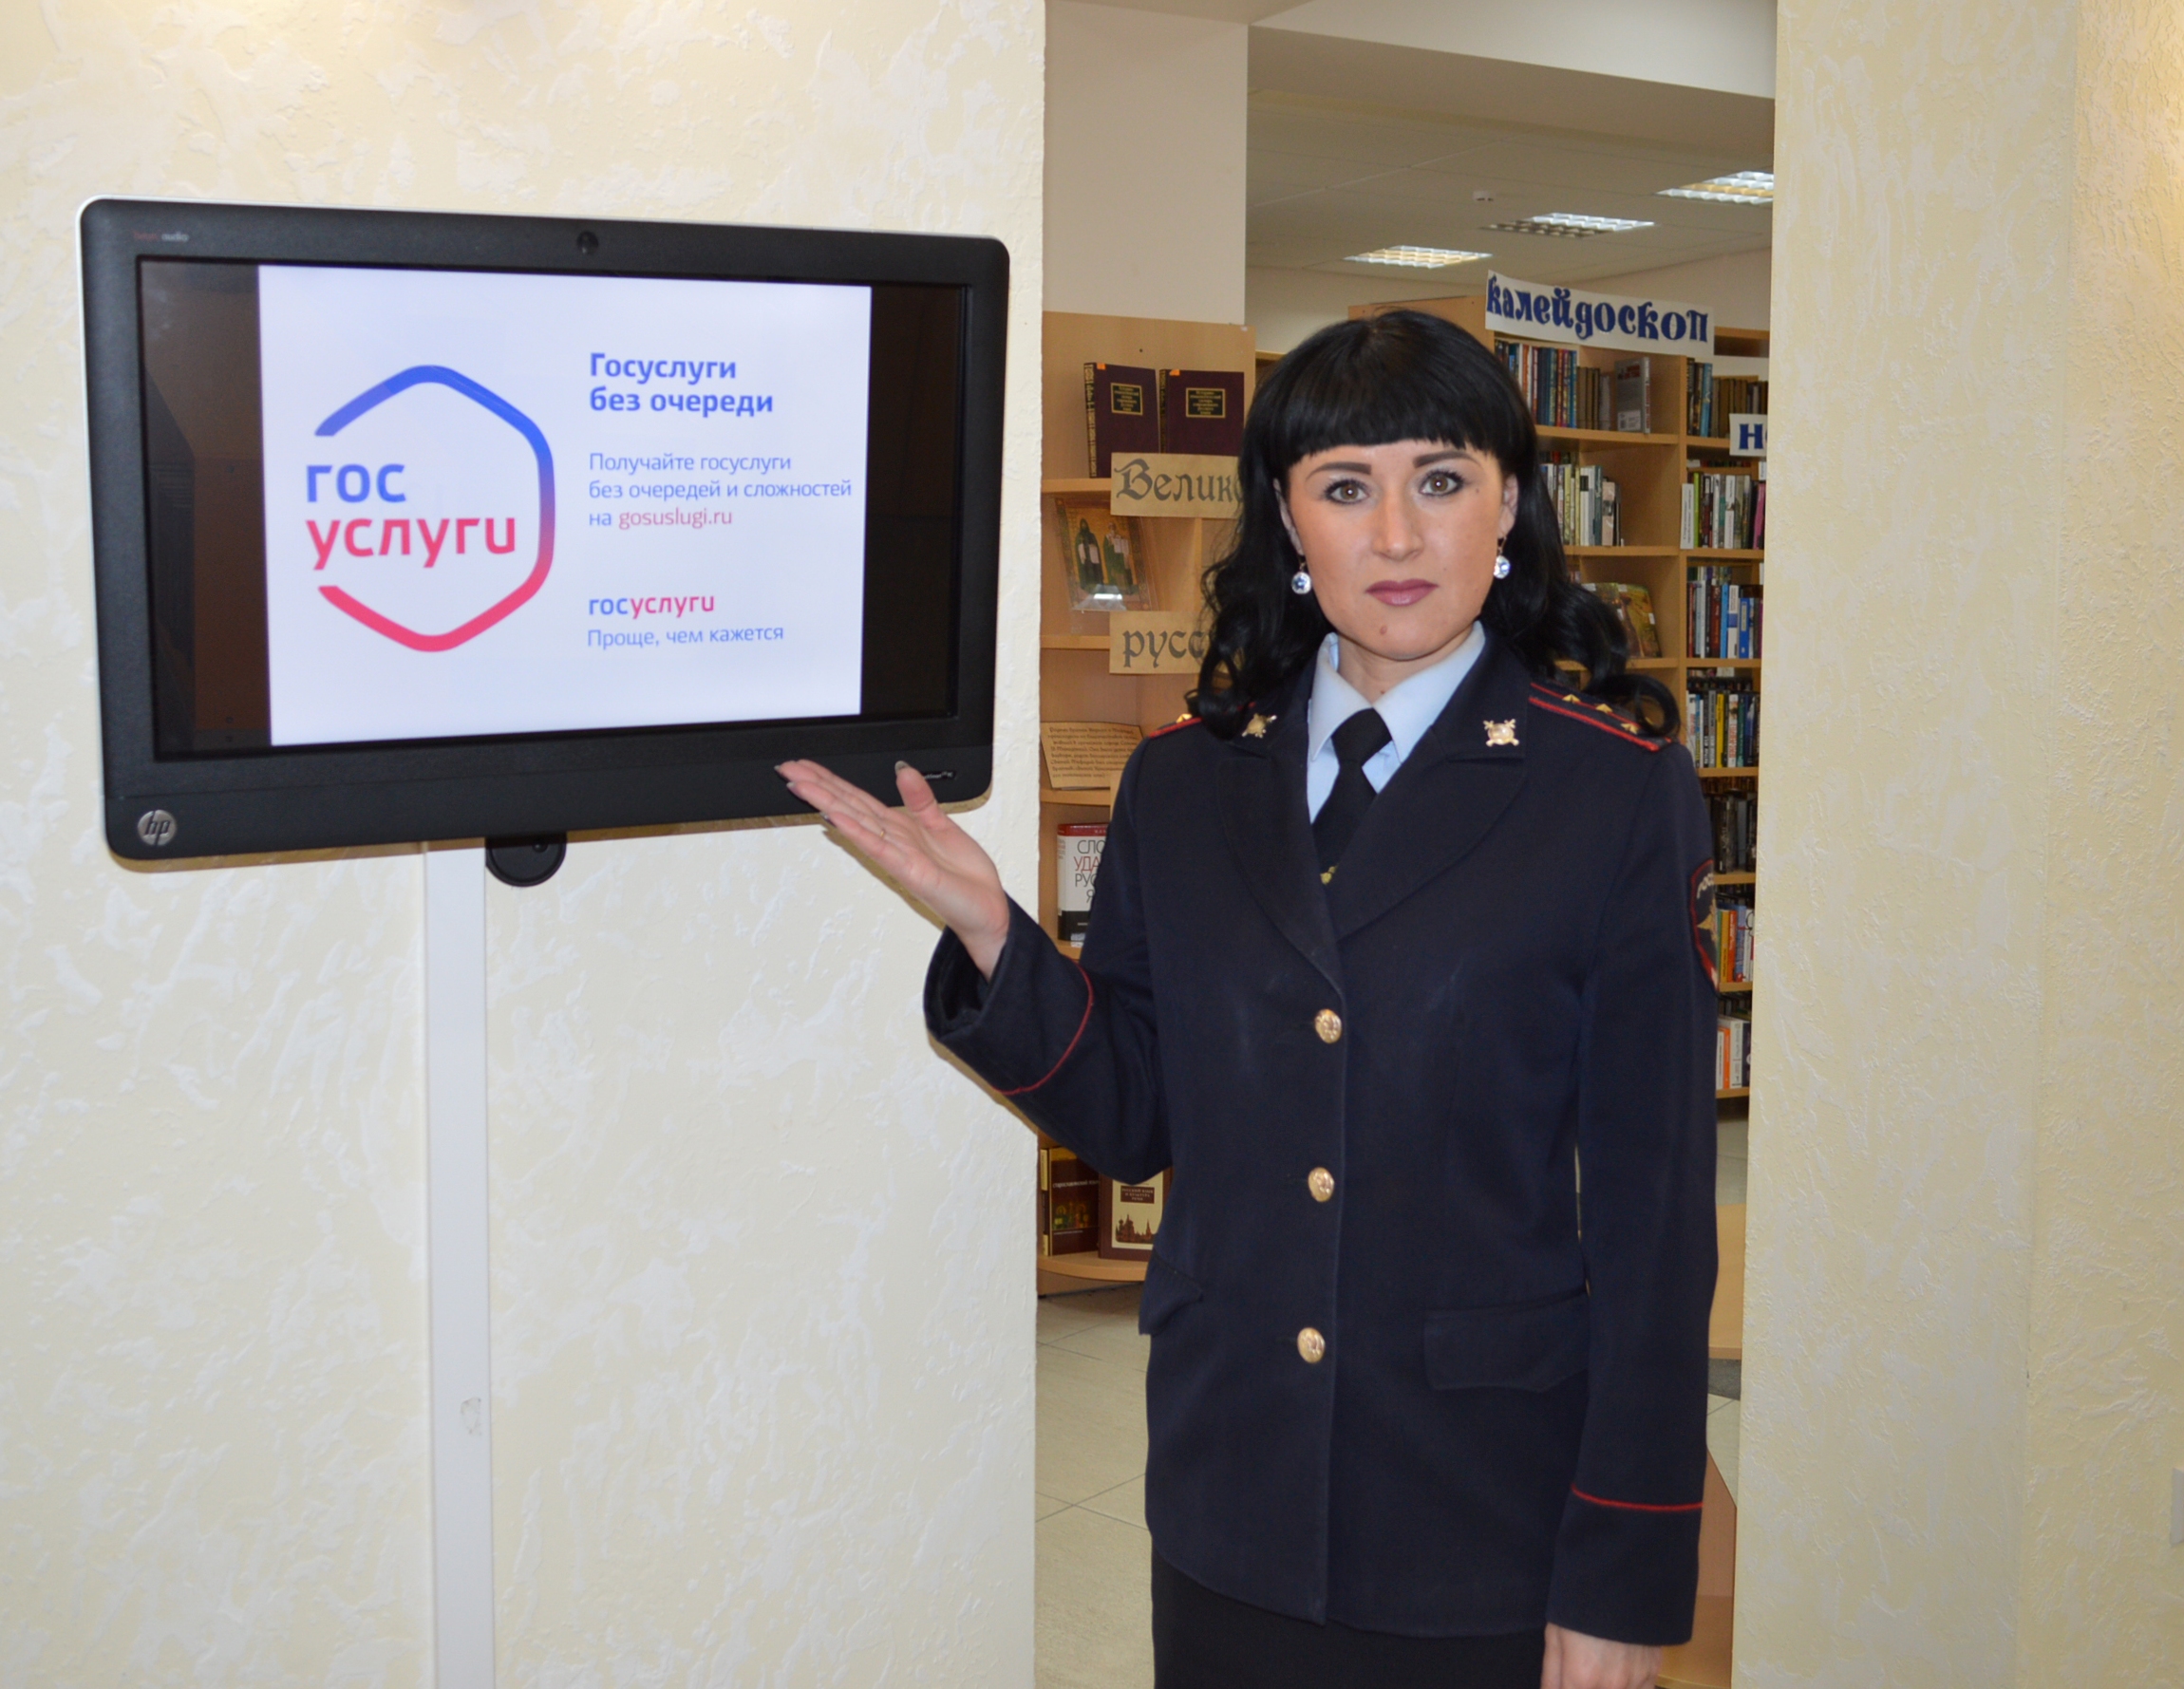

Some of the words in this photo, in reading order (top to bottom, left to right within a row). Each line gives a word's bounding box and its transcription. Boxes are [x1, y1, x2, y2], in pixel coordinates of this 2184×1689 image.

[1486, 274, 1709, 343] калейдоскоп
[590, 352, 737, 385] Госуслуги
[590, 385, 641, 411] без
[650, 393, 774, 419] очереди
[1739, 423, 1768, 450] Н
[589, 452, 695, 476] Получайте
[700, 456, 792, 476] госуслуги
[306, 463, 407, 503] гос
[589, 479, 623, 498] без
[629, 480, 722, 502] очередей
[726, 484, 739, 497] и
[744, 479, 853, 497] сложностей
[589, 512, 612, 527] на
[618, 507, 734, 531] gosuslugi.ru
[305, 516, 516, 571] услуги
[589, 595, 716, 620] госуслуги
[587, 629, 660, 650] Проще,
[666, 629, 704, 644] чем
[709, 627, 784, 643] кажется
[144, 810, 172, 845] hp
